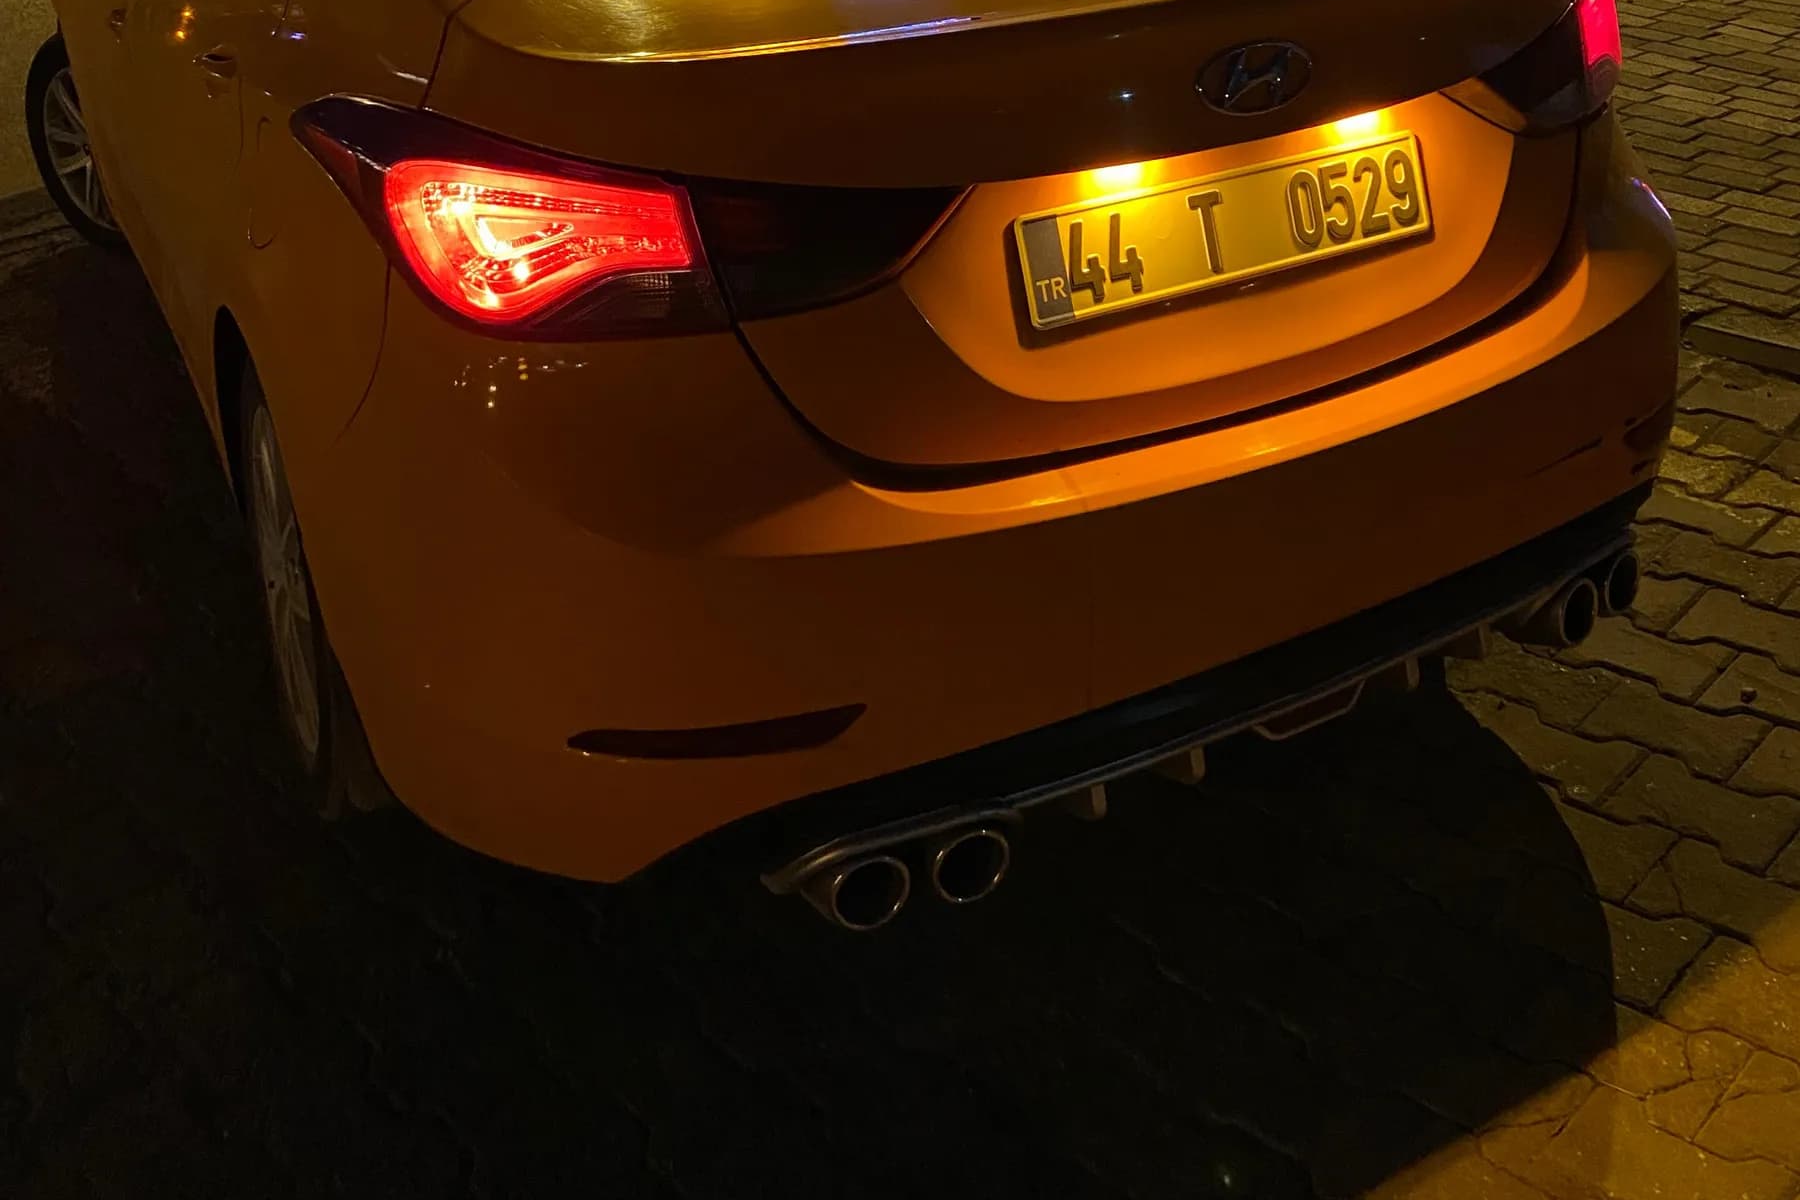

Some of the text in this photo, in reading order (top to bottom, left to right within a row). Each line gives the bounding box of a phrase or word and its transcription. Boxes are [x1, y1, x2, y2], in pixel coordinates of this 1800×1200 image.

[1069, 149, 1420, 303] 44 T 0529
[1035, 275, 1068, 304] TR
